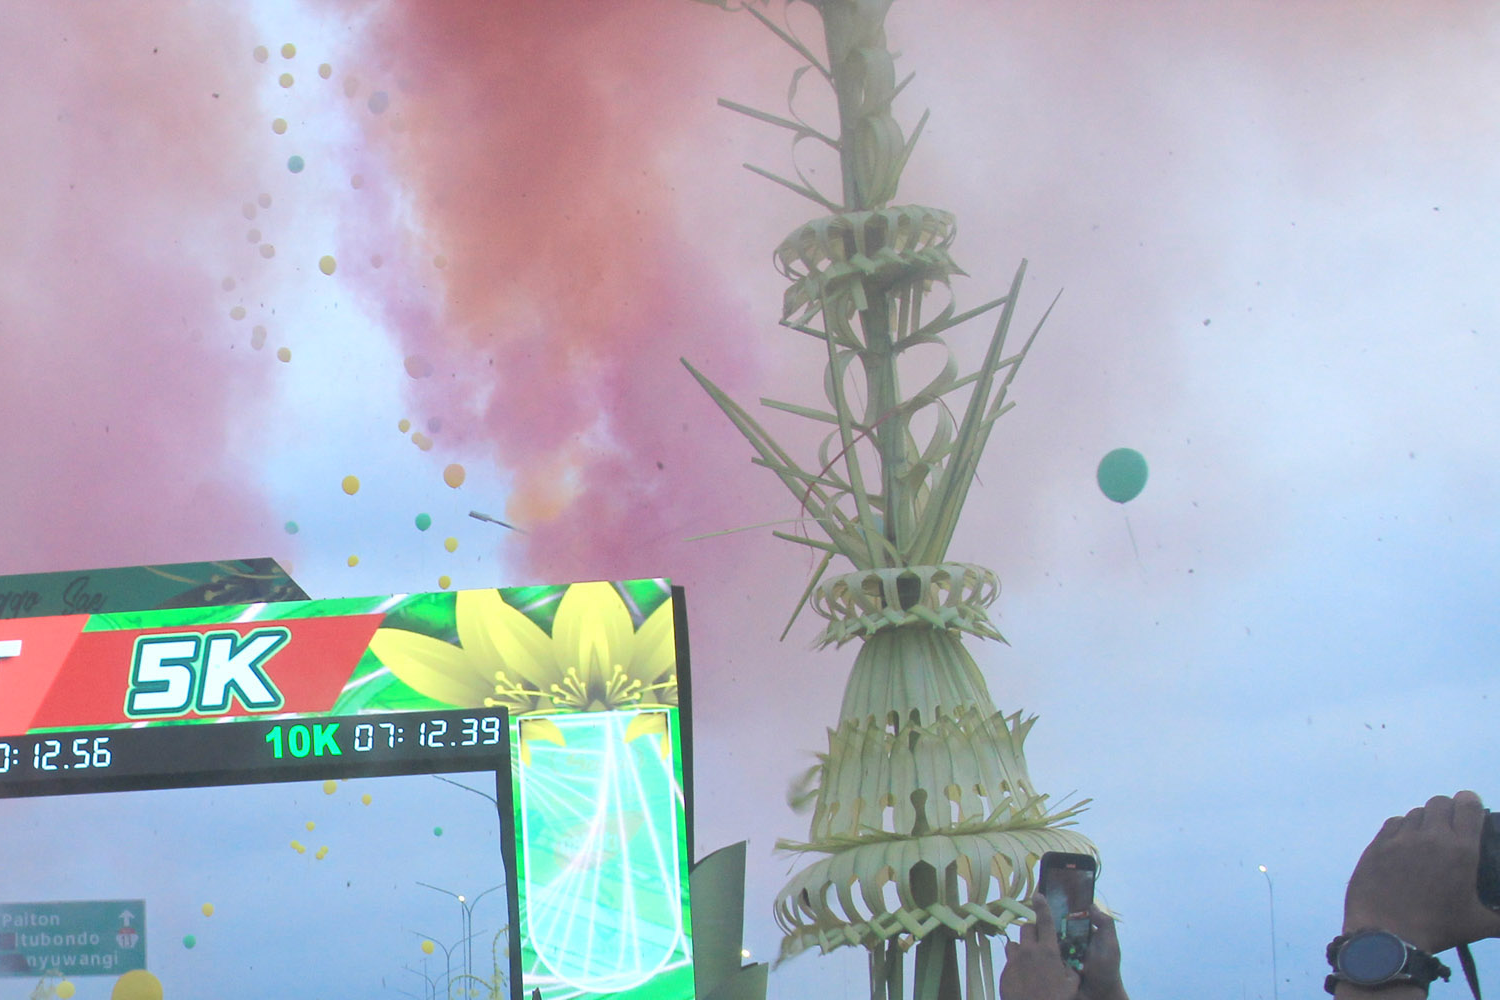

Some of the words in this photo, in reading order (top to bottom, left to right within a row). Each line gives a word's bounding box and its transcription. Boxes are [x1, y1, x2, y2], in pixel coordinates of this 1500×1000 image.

[125, 628, 290, 717] 5K
[265, 723, 342, 759] 10K
[2, 911, 61, 927] Paiton
